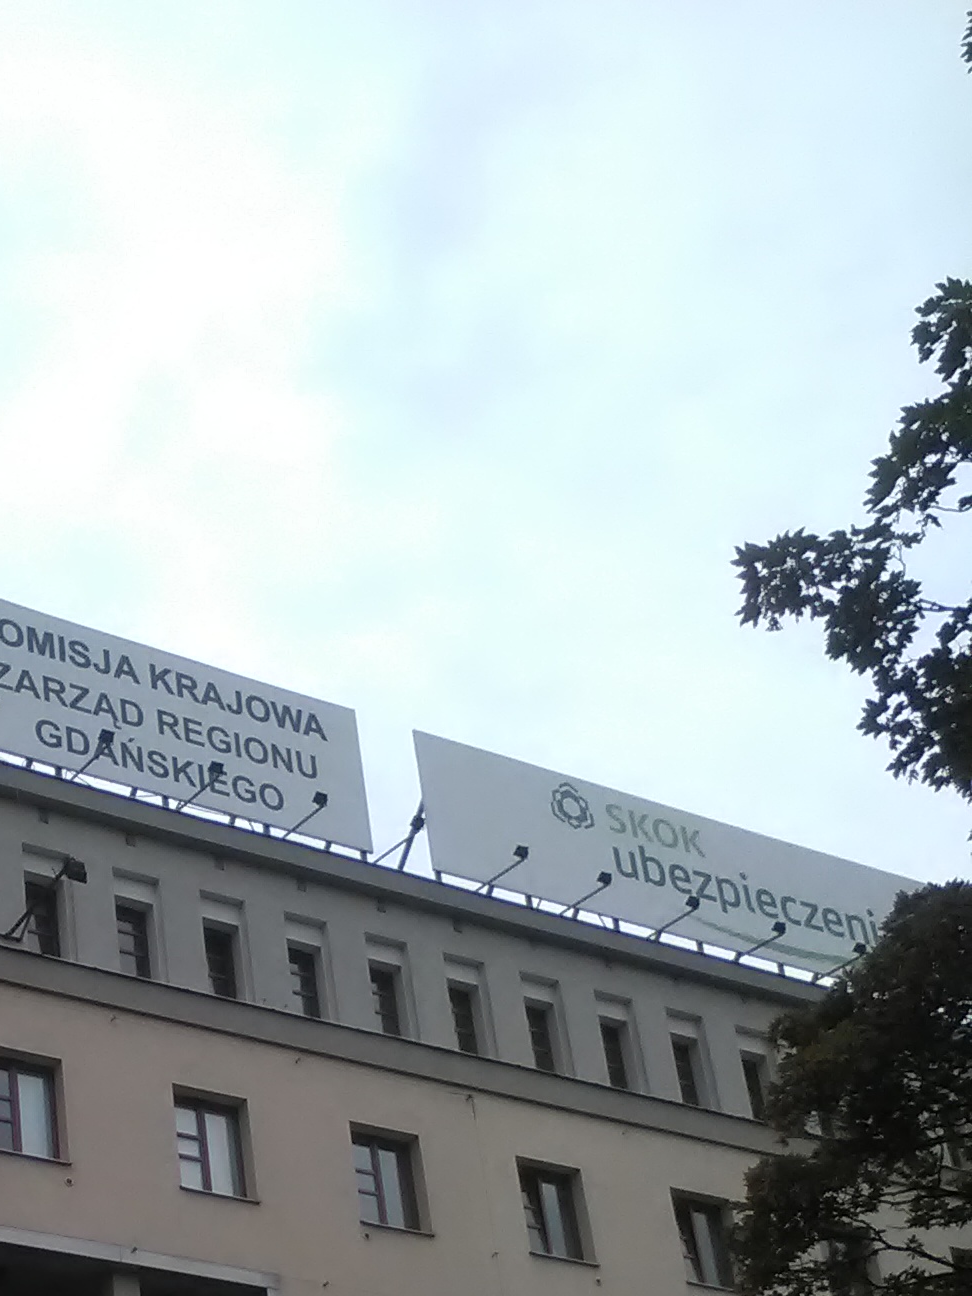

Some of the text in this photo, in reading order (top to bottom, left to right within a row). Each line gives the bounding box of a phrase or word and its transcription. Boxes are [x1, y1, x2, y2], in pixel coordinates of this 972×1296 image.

[148, 662, 329, 742] KRAJOWA
[34, 718, 285, 812] GDAŃSKIEGO
[157, 708, 318, 780] REGIONU
[605, 803, 706, 859] SKOK
[611, 844, 879, 948] ubezpieczeni
